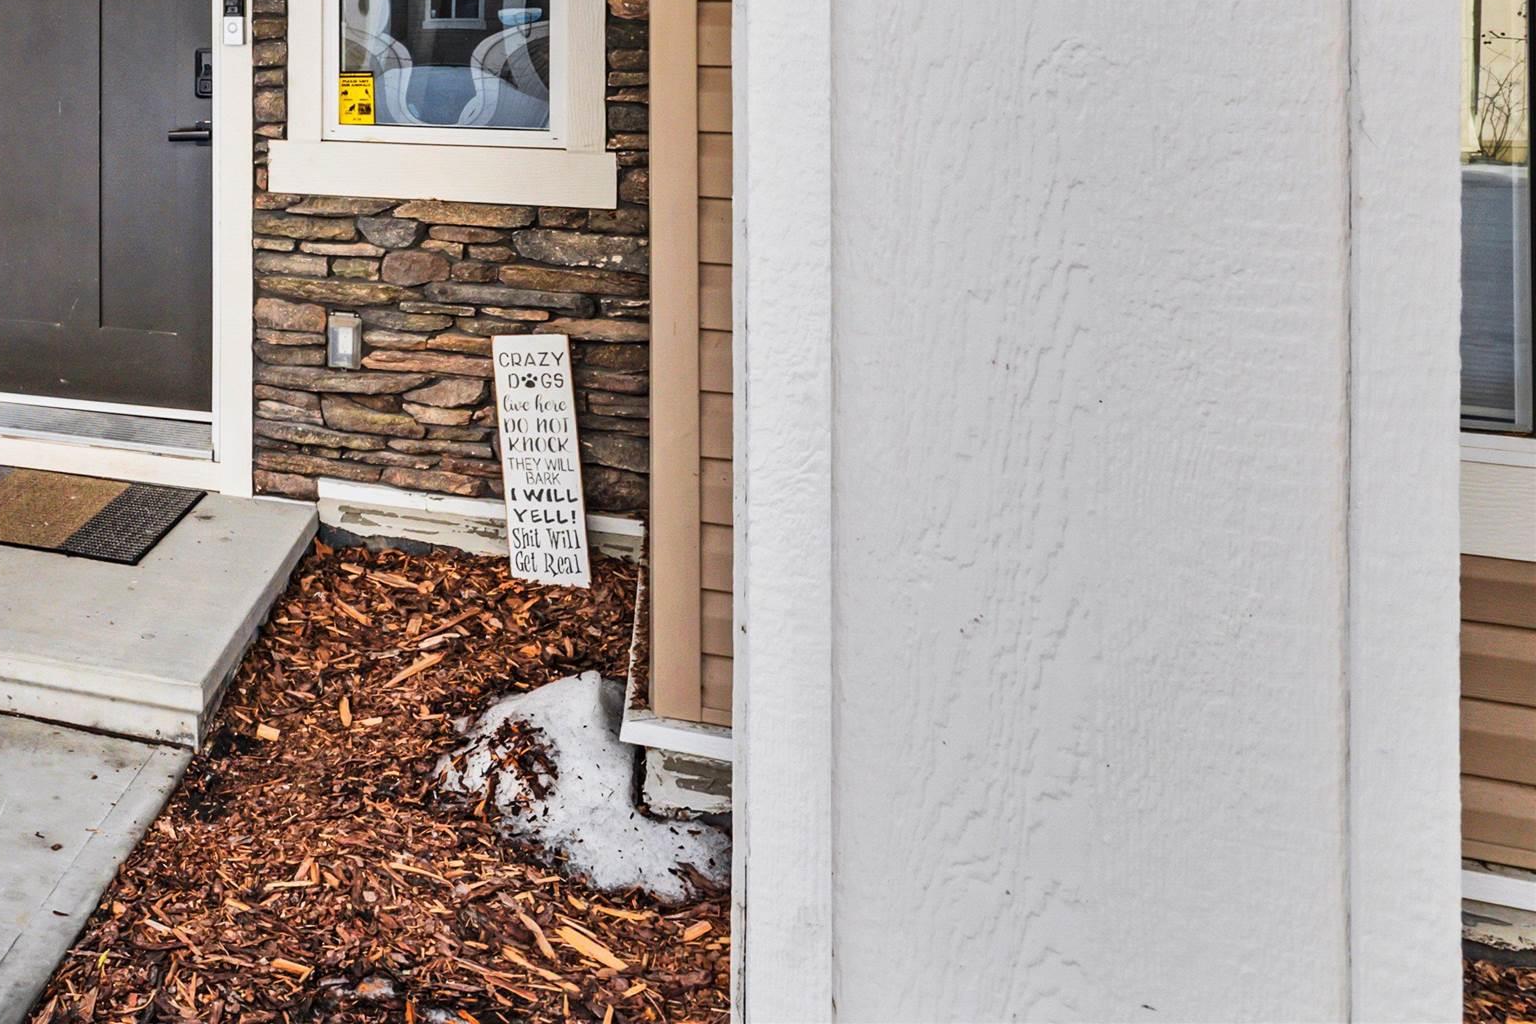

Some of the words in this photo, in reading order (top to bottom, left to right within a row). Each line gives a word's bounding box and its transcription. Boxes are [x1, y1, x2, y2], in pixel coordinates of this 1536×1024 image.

[498, 351, 565, 368] CRAZY
[503, 394, 530, 413] live
[535, 394, 567, 413] here
[504, 417, 529, 434] DO
[507, 457, 541, 471] THEY
[544, 458, 575, 472] WILL
[525, 471, 562, 486] BARK
[510, 487, 518, 502] I
[522, 488, 579, 503] WILL
[513, 508, 577, 525] YELL!
[512, 527, 541, 550] Shit
[546, 528, 581, 550] Will
[515, 550, 538, 573] Get
[543, 552, 583, 577] Real
